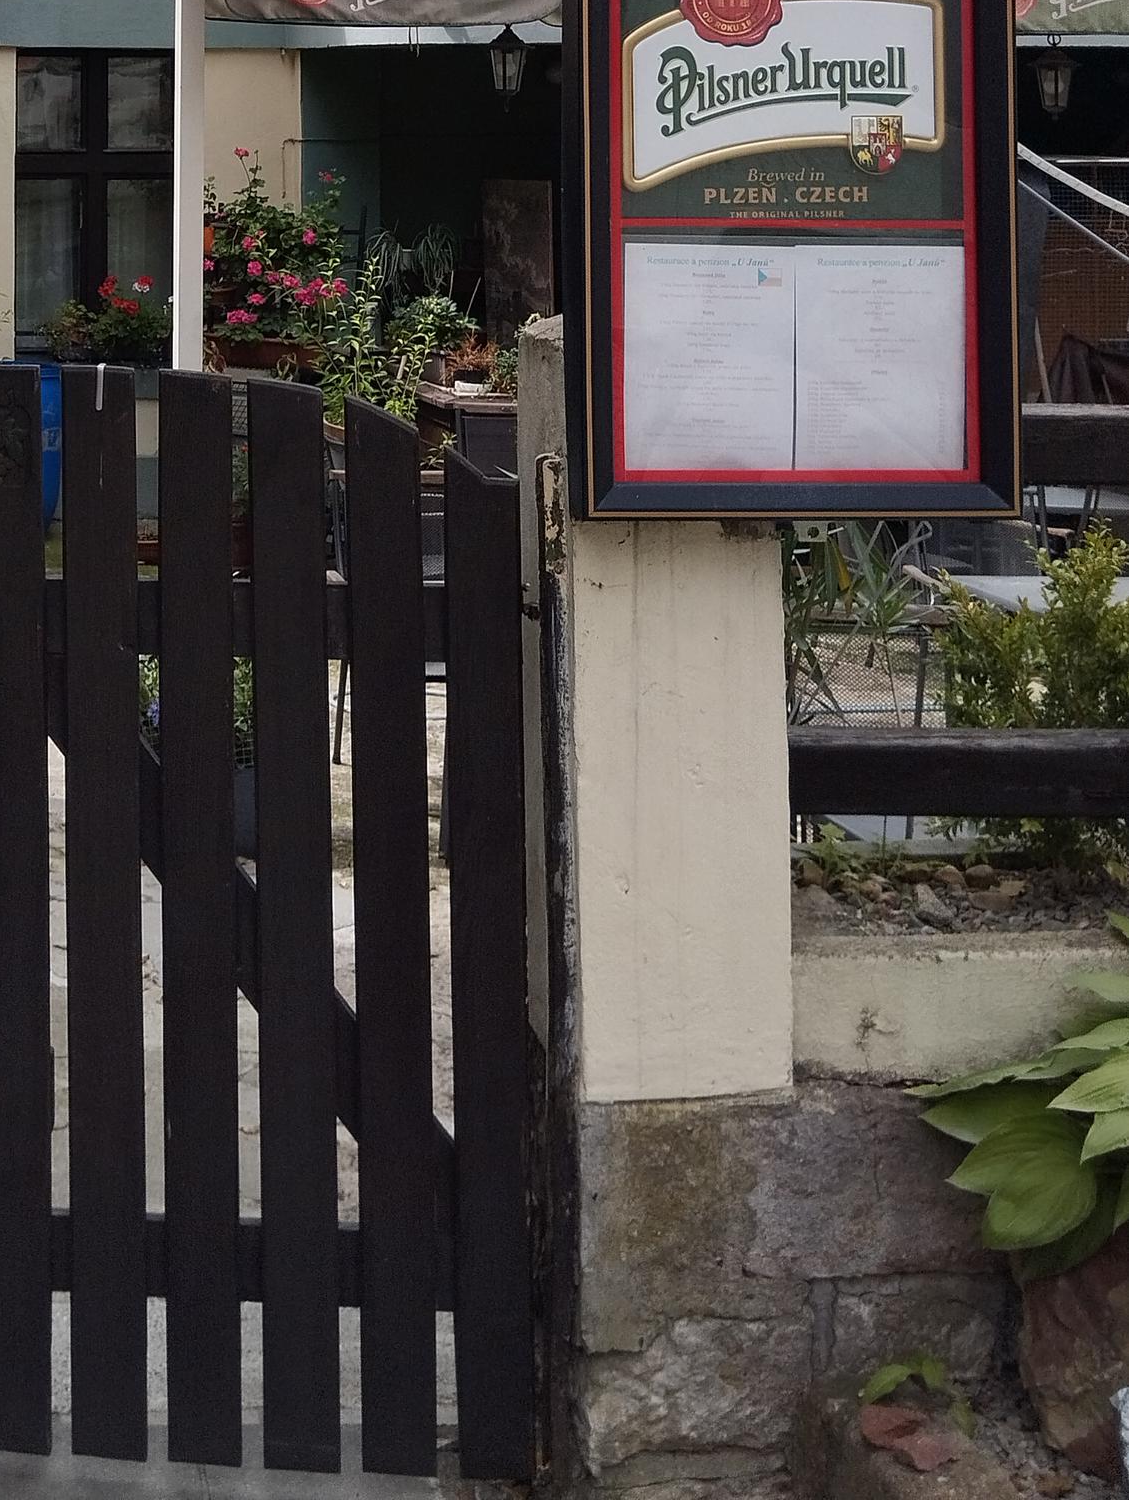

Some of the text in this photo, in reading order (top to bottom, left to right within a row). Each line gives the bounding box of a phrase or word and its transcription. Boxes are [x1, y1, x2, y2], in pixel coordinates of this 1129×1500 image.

[656, 41, 908, 138] Pilsner Urquell
[746, 167, 825, 182] Brewed in
[795, 186, 869, 203] CZECH
[729, 209, 846, 219] THE ORIGINAL PILSNER
